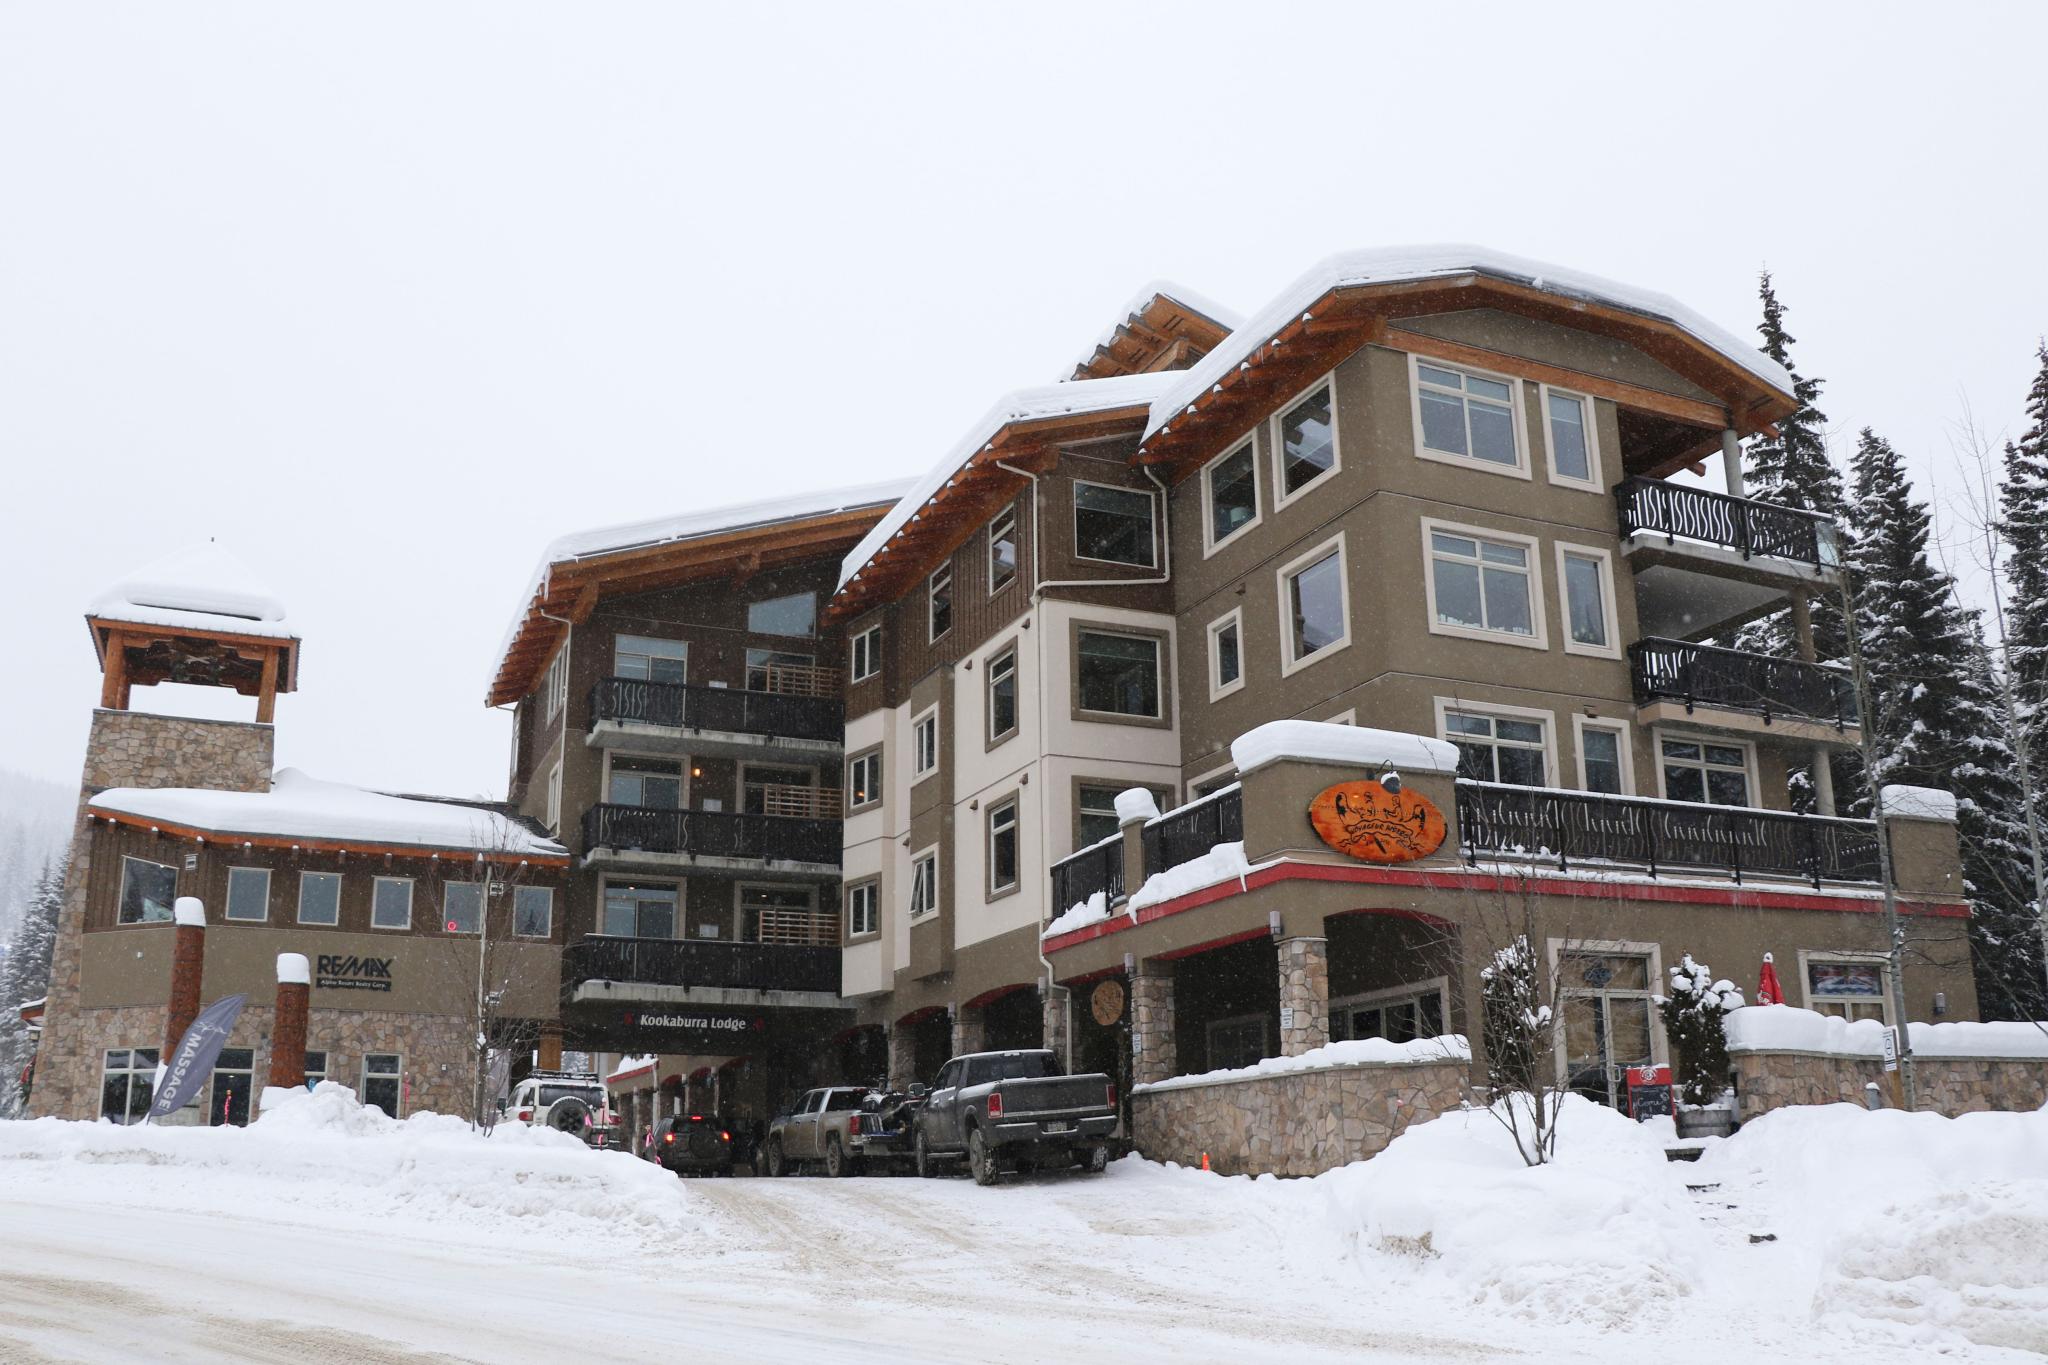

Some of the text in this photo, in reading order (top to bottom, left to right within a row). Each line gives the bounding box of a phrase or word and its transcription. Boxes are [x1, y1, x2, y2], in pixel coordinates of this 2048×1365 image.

[317, 954, 393, 978] RE/MAX
[640, 1014, 747, 1032] Kookaburra Lodge
[158, 1032, 202, 1110] MASSAGE
